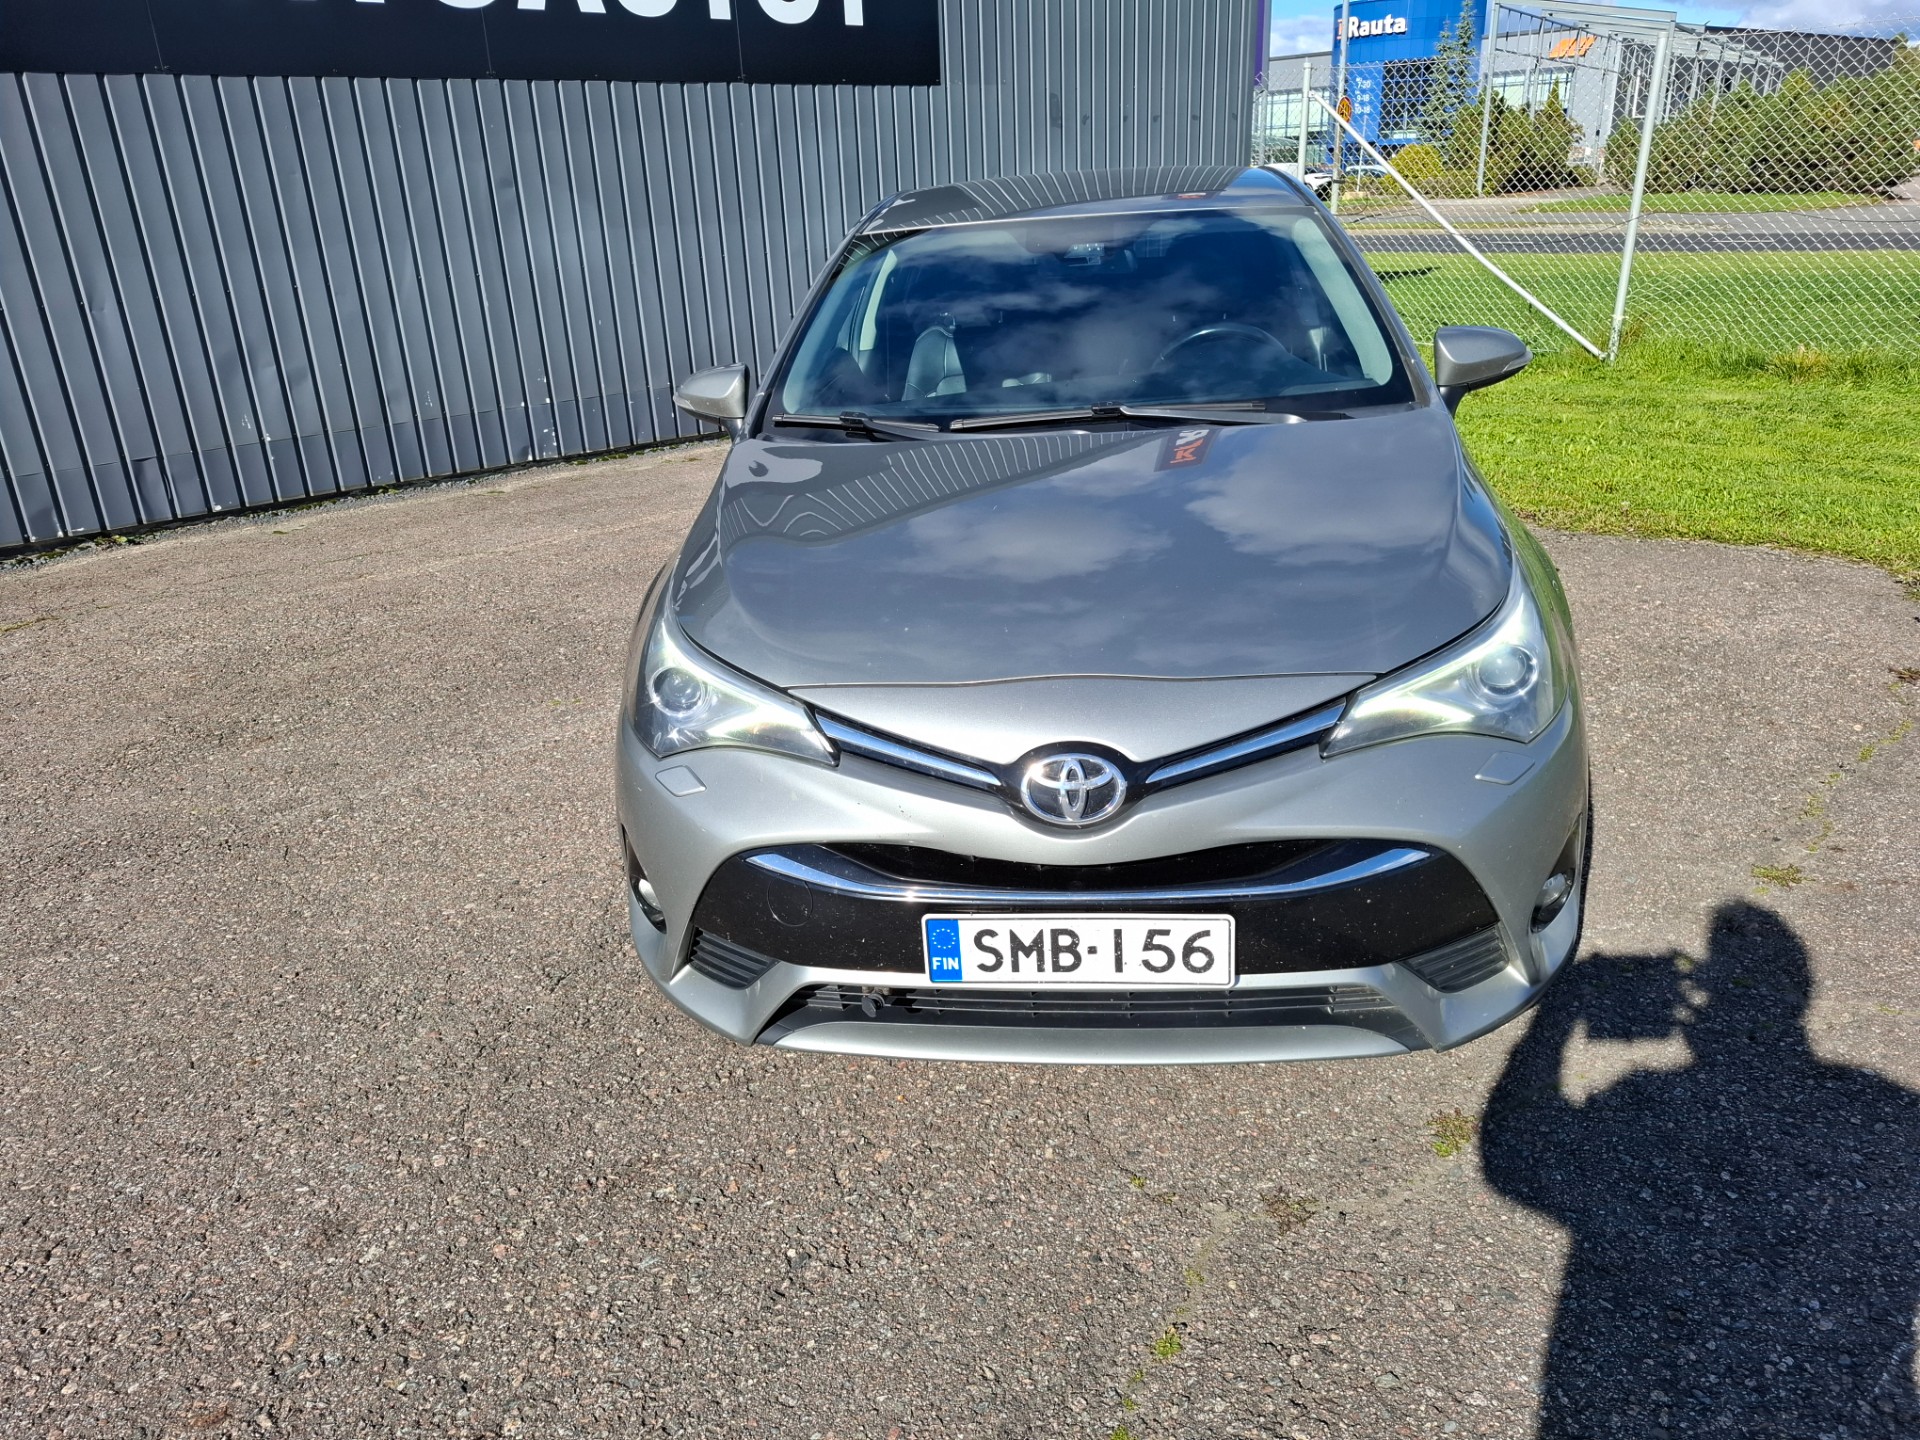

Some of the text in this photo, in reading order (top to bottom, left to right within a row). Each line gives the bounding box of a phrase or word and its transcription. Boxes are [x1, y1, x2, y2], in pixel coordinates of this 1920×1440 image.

[1348, 14, 1407, 38] Rauta
[973, 928, 1215, 974] SMB-156
[932, 956, 960, 971] FIN
